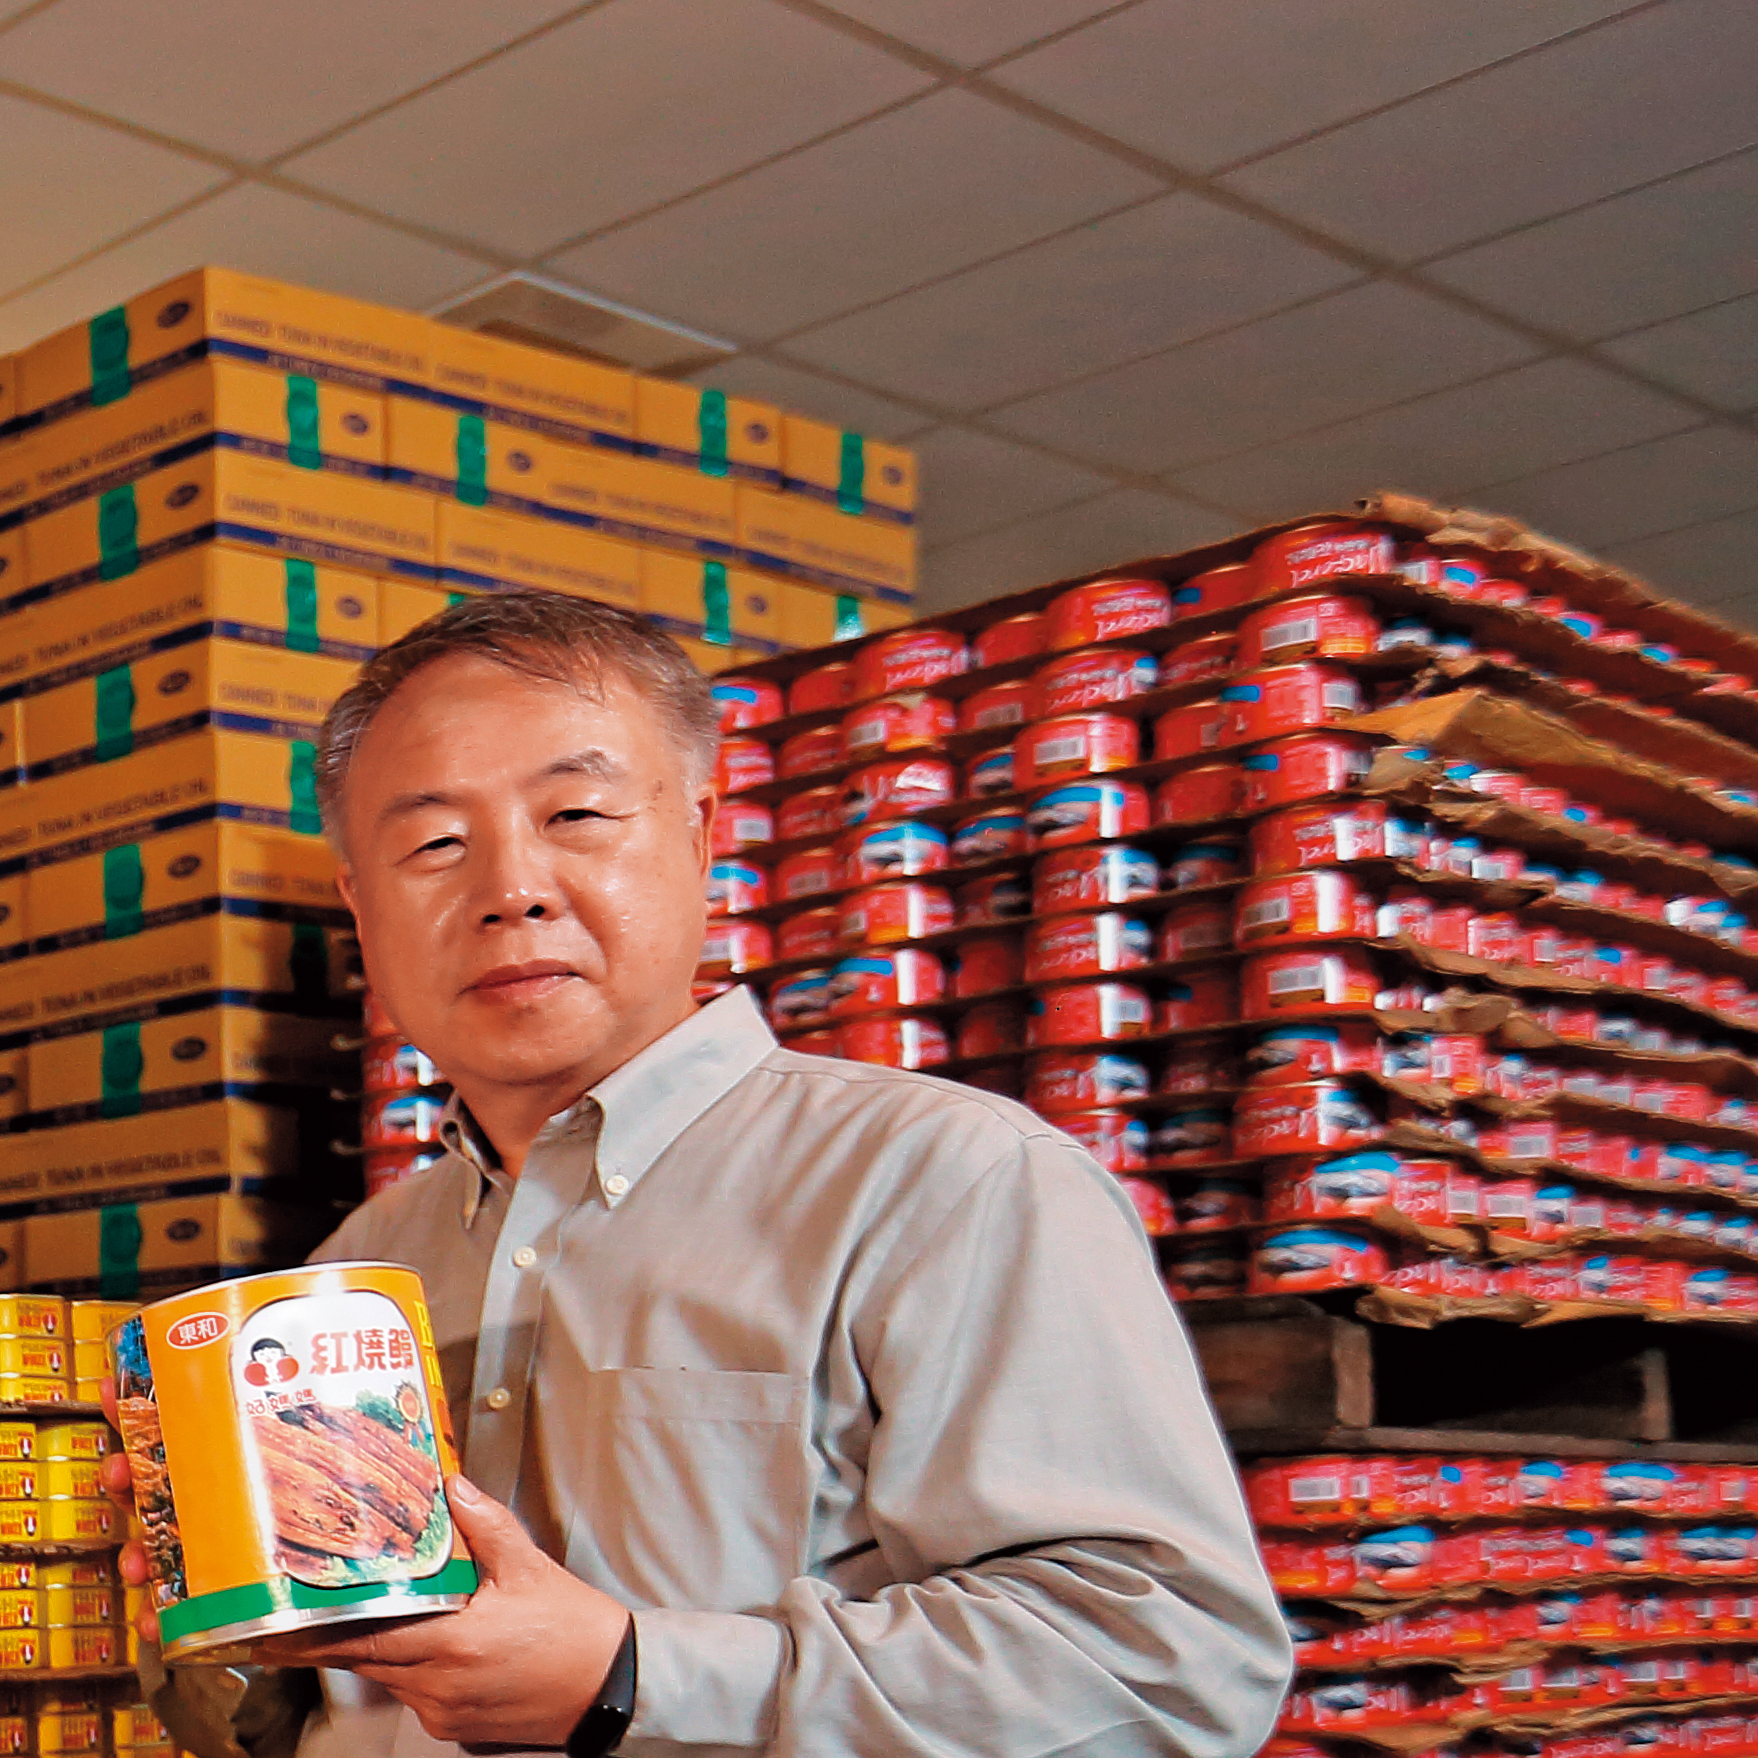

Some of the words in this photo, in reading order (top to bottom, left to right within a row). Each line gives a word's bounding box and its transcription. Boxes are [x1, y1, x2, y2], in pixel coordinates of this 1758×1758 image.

[178, 1317, 219, 1345] 東和
[309, 1328, 415, 1375] 紅燒鰻
[246, 1388, 315, 1416] 好媽媽
